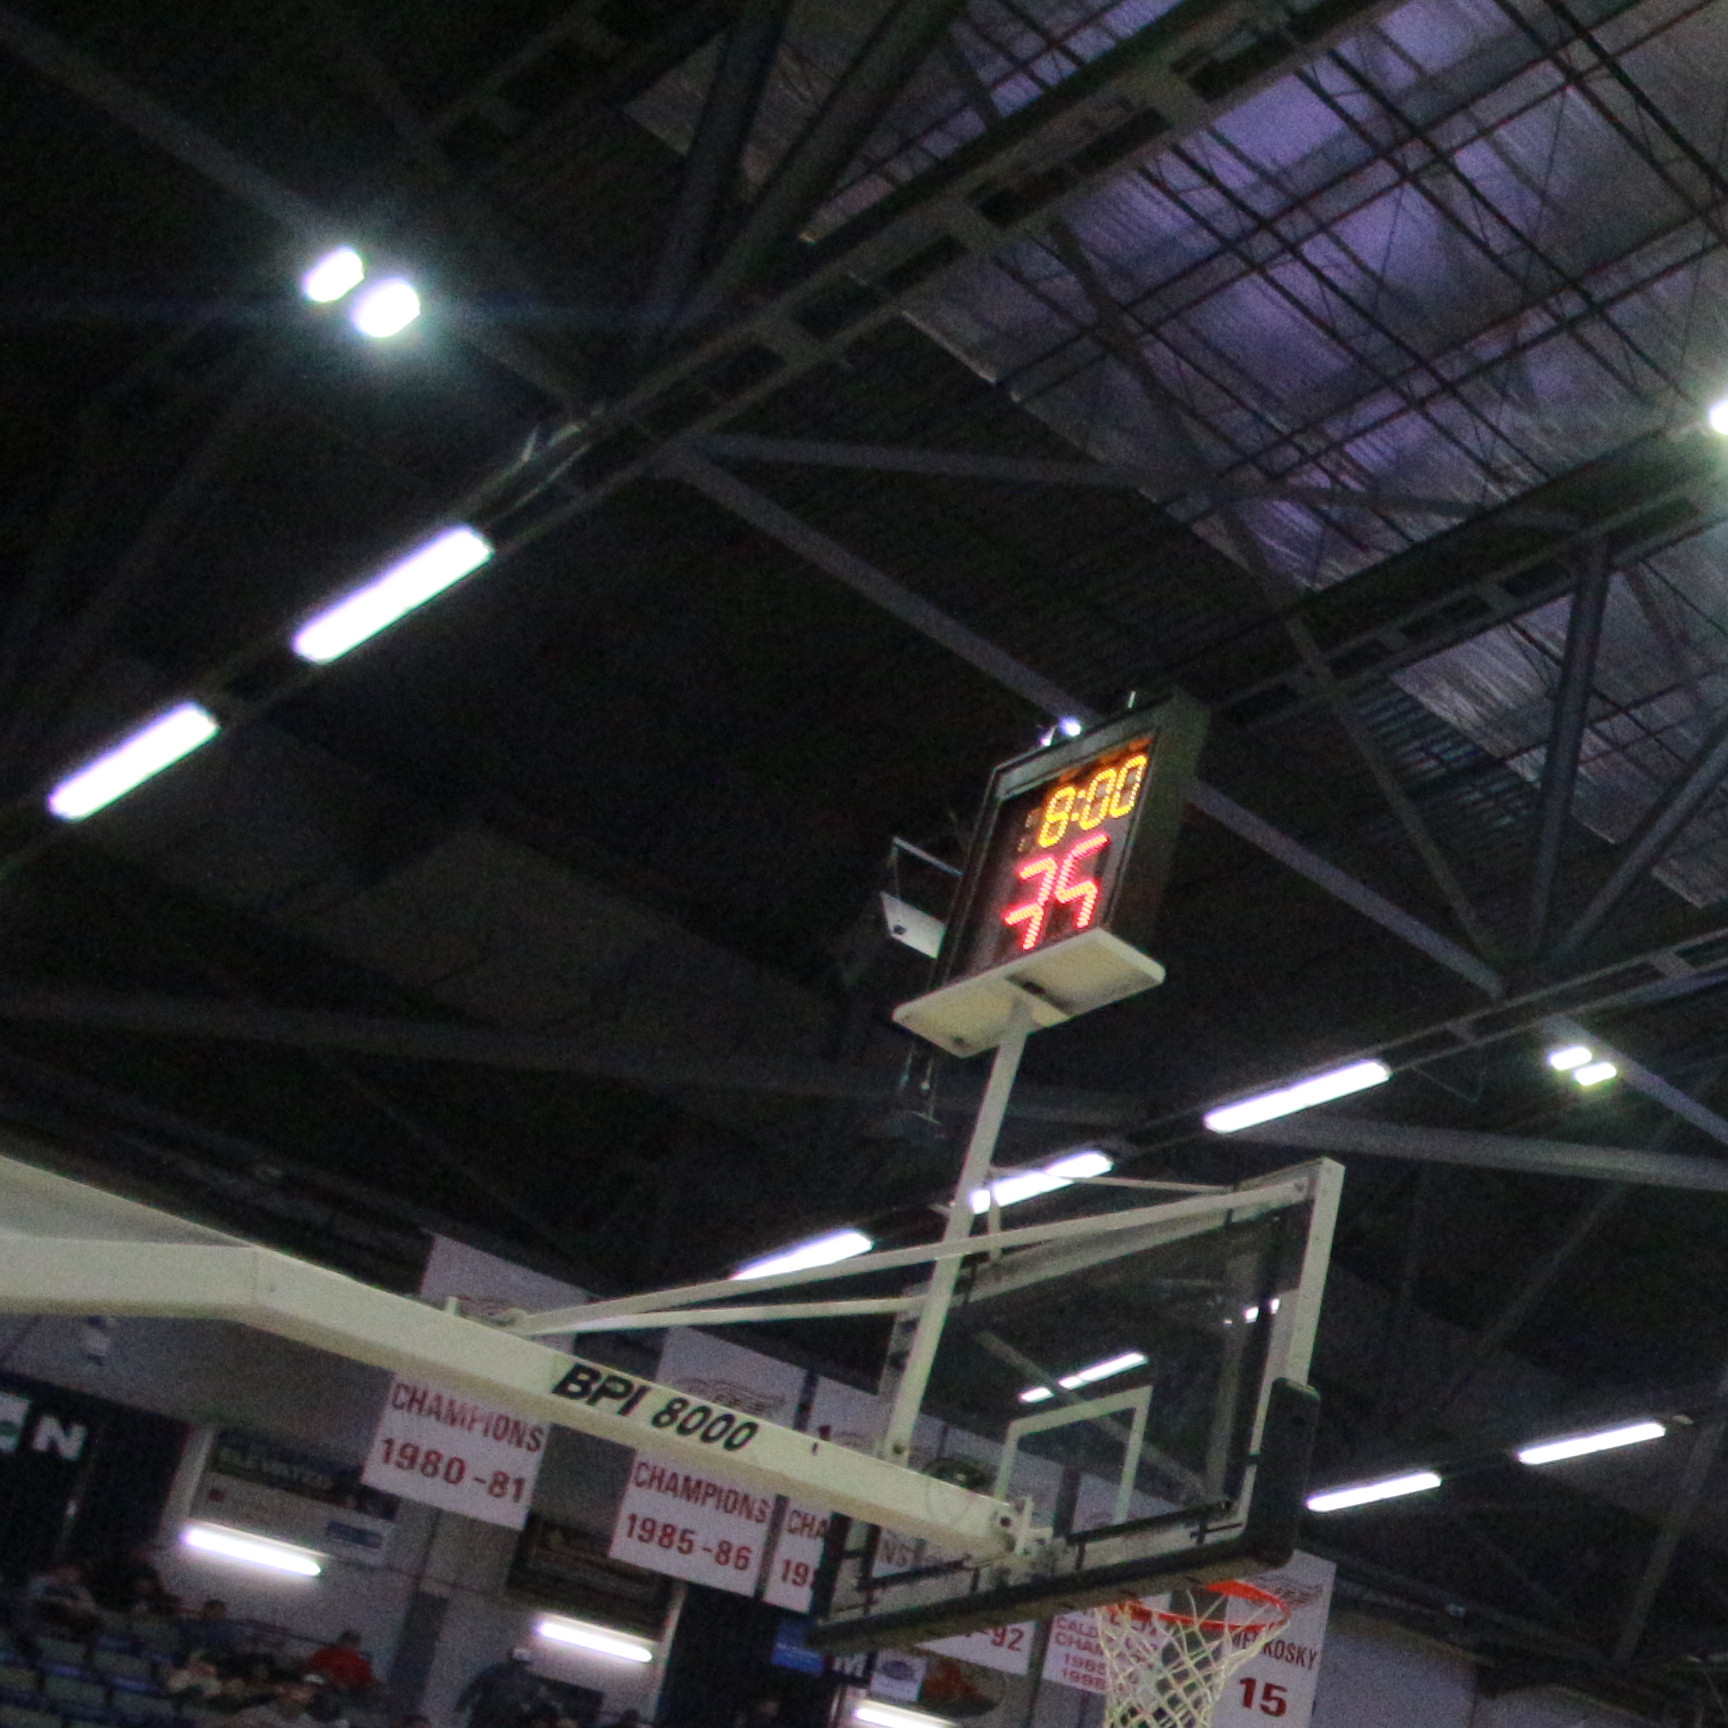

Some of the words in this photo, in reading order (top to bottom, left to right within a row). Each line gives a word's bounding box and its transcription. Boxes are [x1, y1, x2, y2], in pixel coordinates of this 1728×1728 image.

[1037, 753, 1149, 848] 8:00
[390, 1382, 547, 1454] CHAMPIONS
[552, 1362, 650, 1417] BPI
[651, 1396, 761, 1452] 8000
[633, 1460, 772, 1524] CHAMPIONS
[1238, 1676, 1289, 1718] 15
